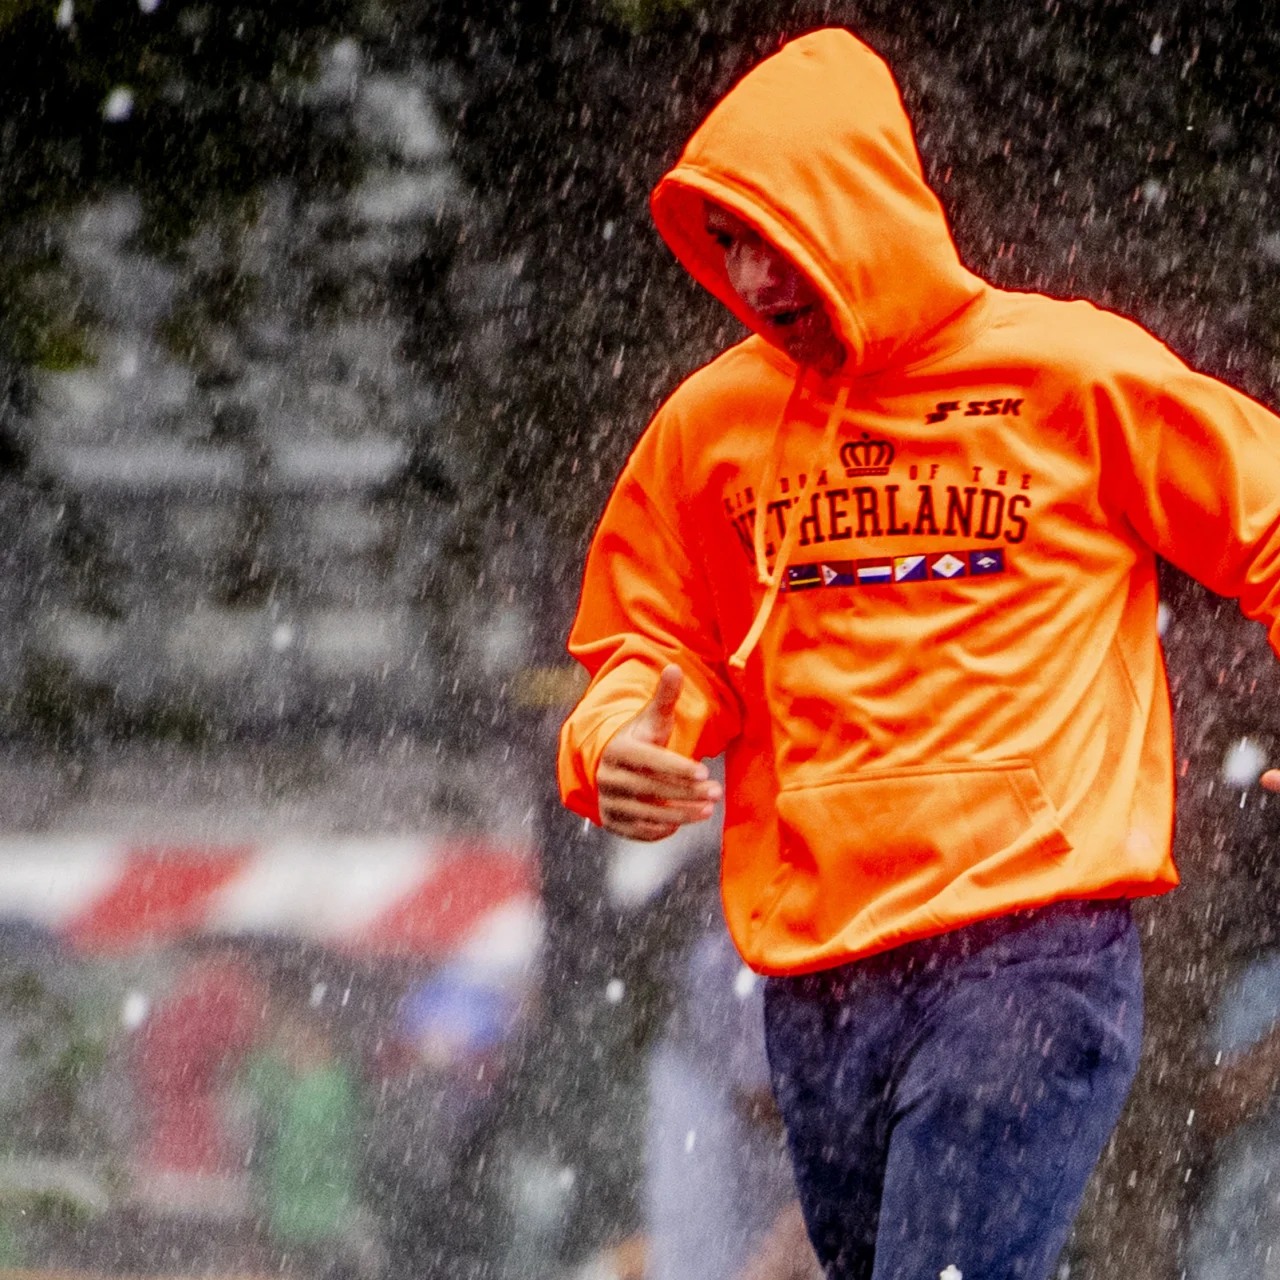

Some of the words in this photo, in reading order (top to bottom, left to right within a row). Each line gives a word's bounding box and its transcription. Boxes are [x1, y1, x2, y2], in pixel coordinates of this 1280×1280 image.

[963, 398, 1025, 416] SSK
[909, 464, 940, 480] OF
[972, 466, 1032, 490] THE
[730, 484, 1032, 565] NTHERLANDS
